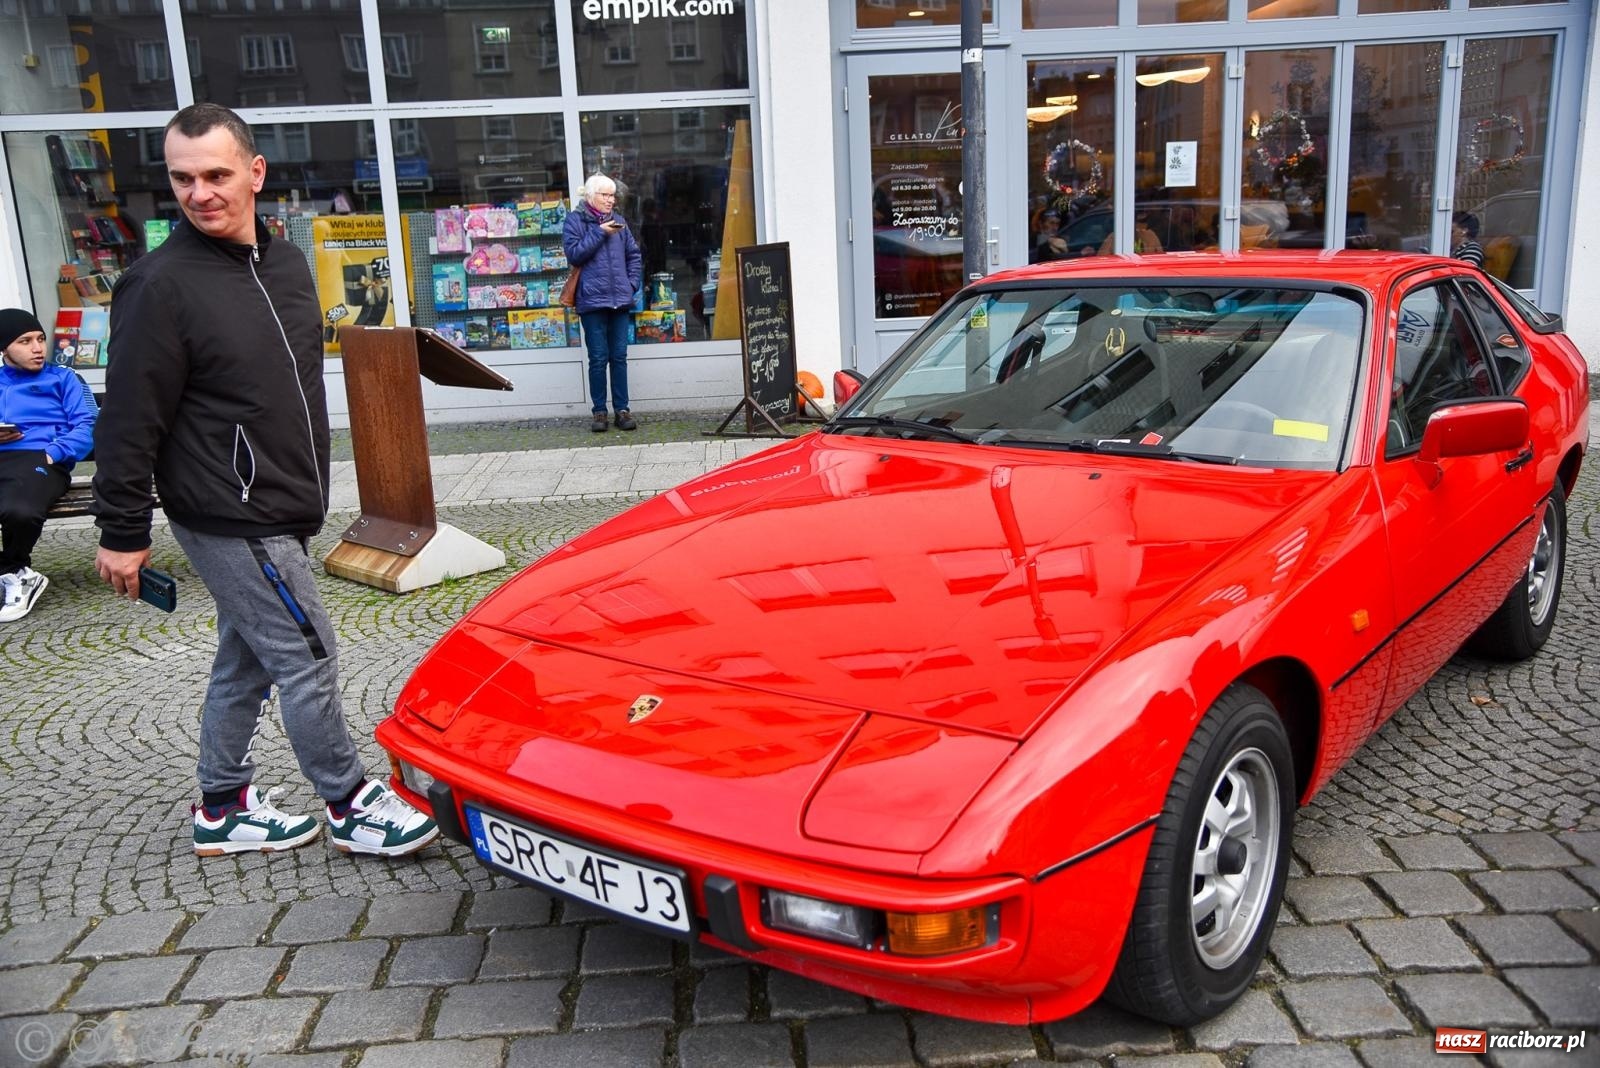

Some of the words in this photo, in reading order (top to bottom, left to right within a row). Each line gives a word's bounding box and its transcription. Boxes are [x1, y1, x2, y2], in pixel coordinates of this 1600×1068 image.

[583, 0, 735, 25] empik.com
[889, 132, 932, 141] GELATO
[330, 220, 355, 229] Witaj
[893, 212, 946, 230] Zapraszamy
[948, 212, 959, 225] do
[908, 224, 944, 242] 19:00
[355, 239, 375, 247] Black
[476, 838, 489, 852] PL
[488, 820, 567, 885] SRC
